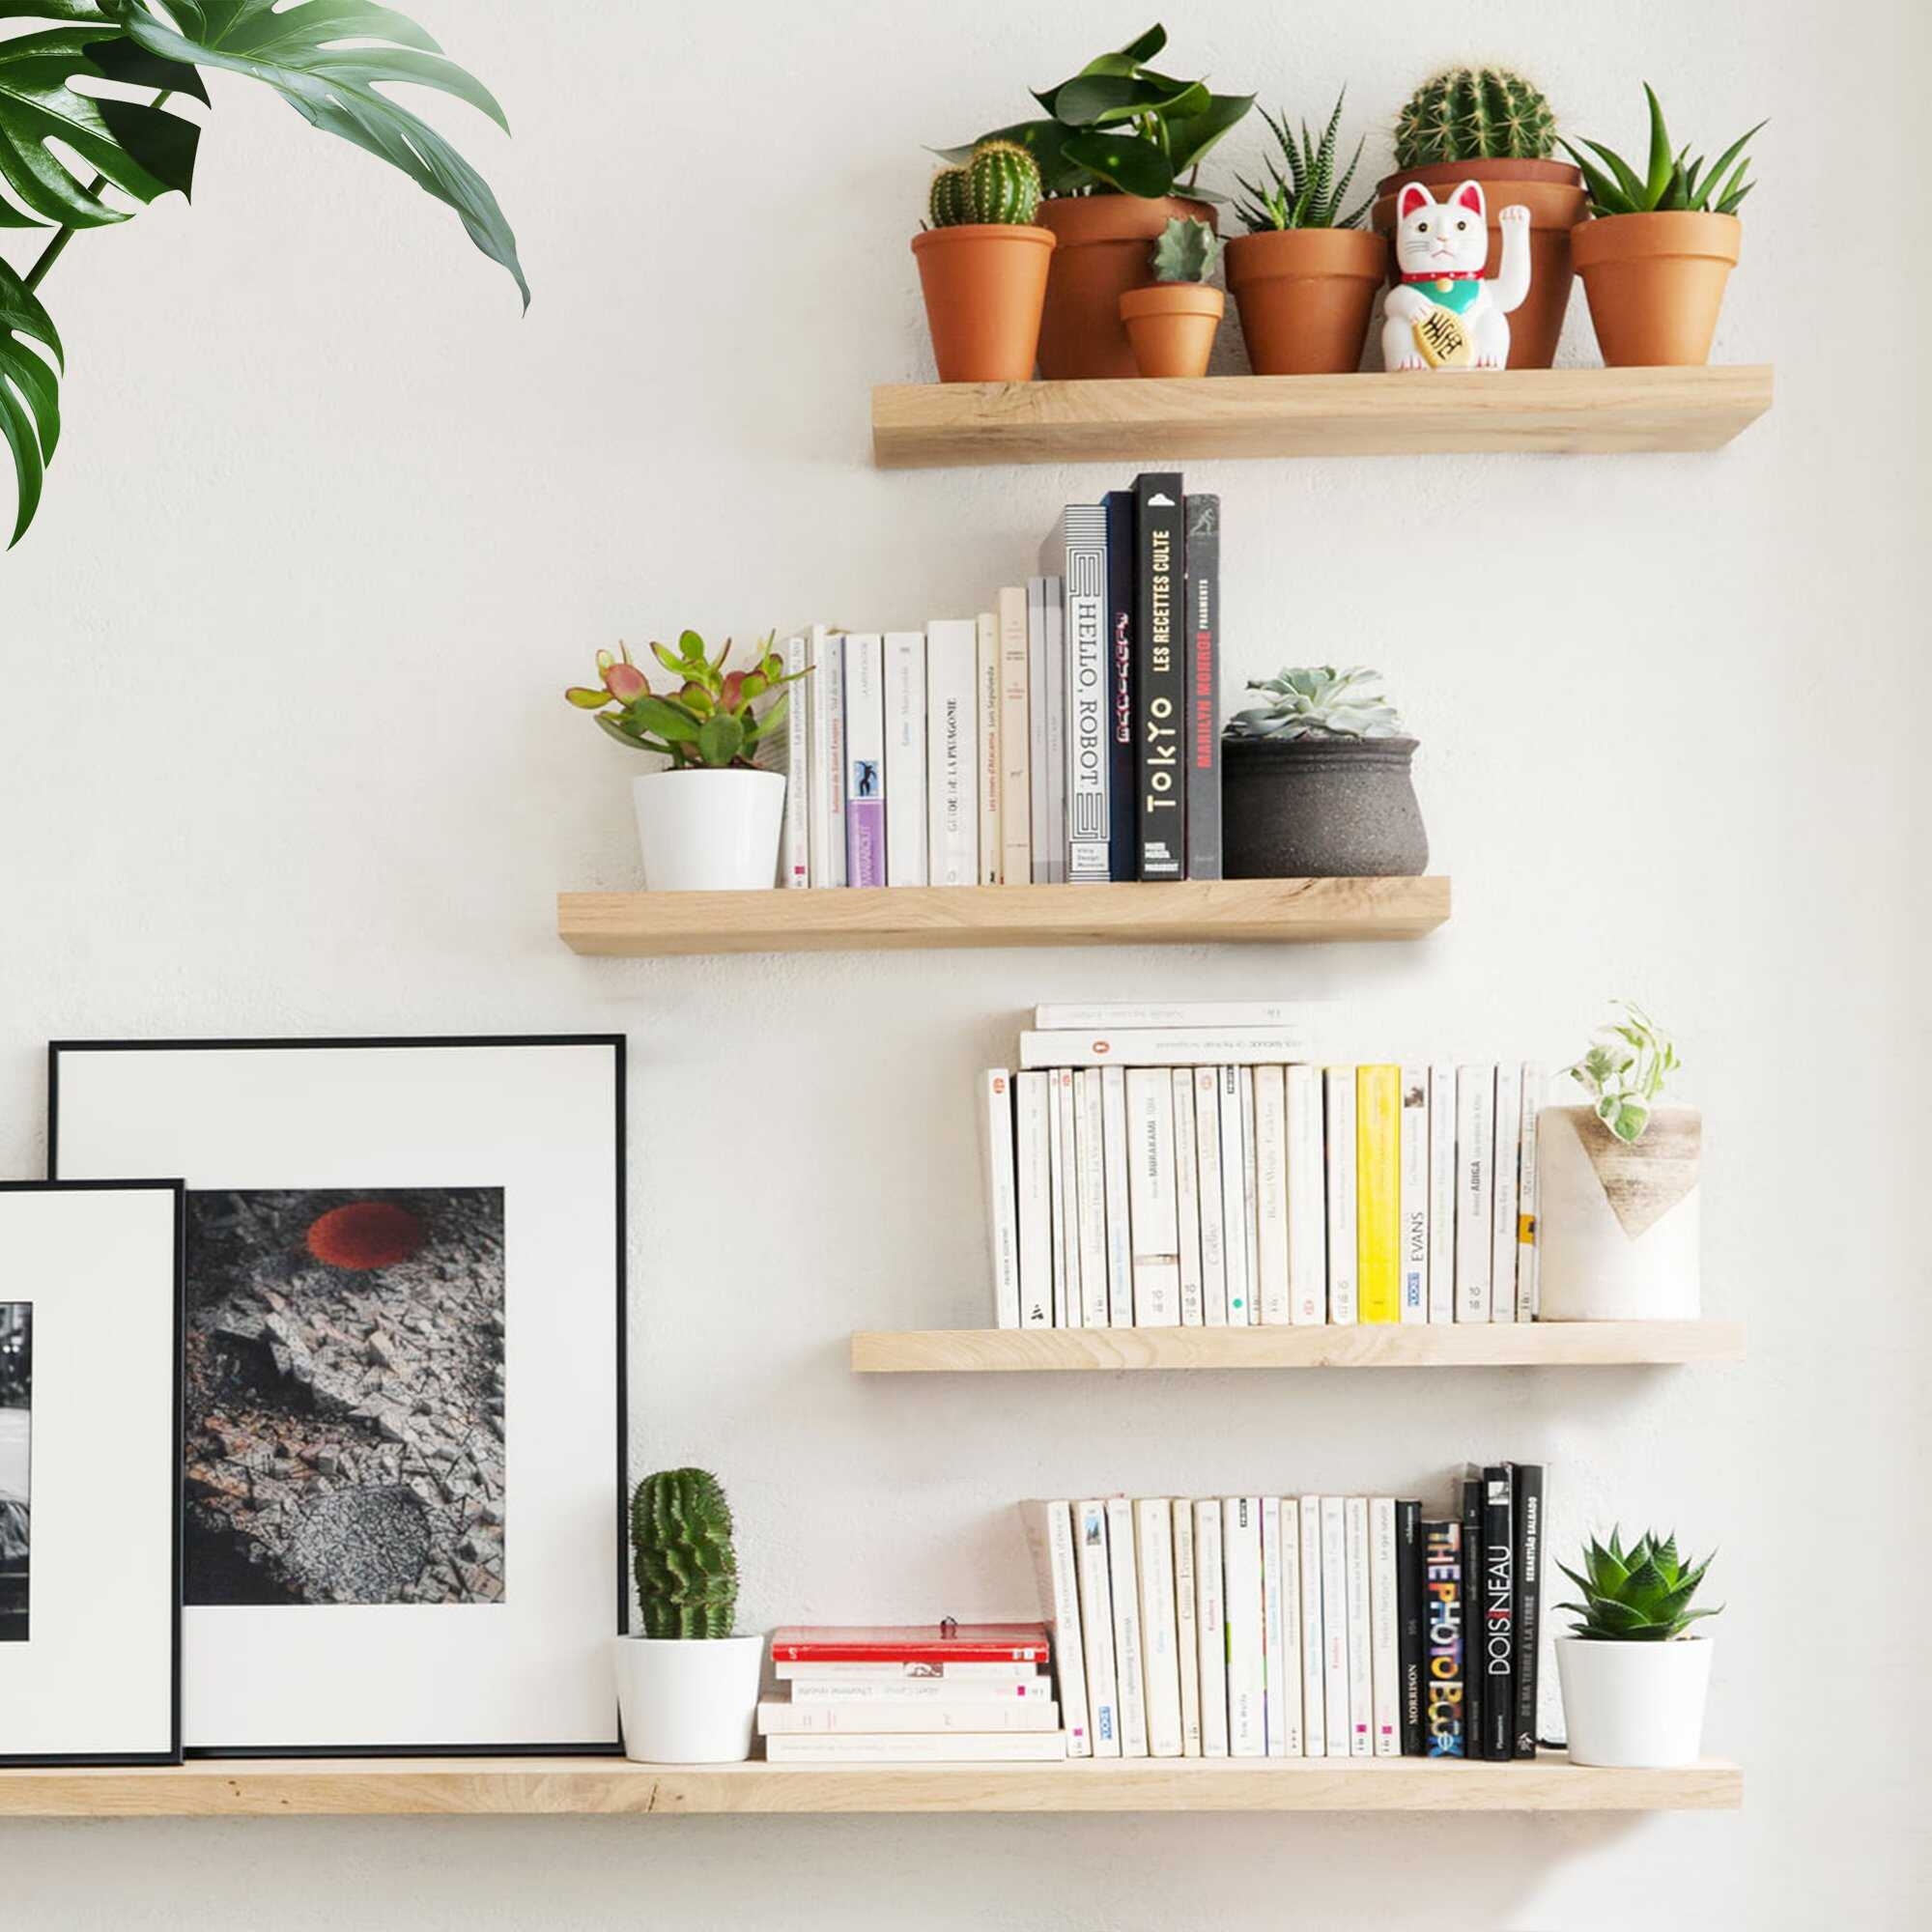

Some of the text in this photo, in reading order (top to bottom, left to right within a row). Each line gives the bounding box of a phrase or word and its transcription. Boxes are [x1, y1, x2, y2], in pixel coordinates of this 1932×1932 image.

[1152, 530, 1170, 672] LES RECETTES CULTE
[1077, 604, 1098, 785] HELLO, ROBOT
[1196, 631, 1212, 768] MARILYN MONROE
[947, 697, 957, 759] PATAGONIE
[947, 760, 957, 776] LA
[1147, 1121, 1158, 1177] MURAKAMI
[1471, 1161, 1481, 1192] ADIGA
[1410, 1211, 1424, 1262] EVANS
[1488, 1545, 1511, 1676] DOISNEAU
[1523, 1628, 1533, 1641] LA
[1524, 1595, 1534, 1626] TERRE
[1407, 1664, 1418, 1725] MORRISON
